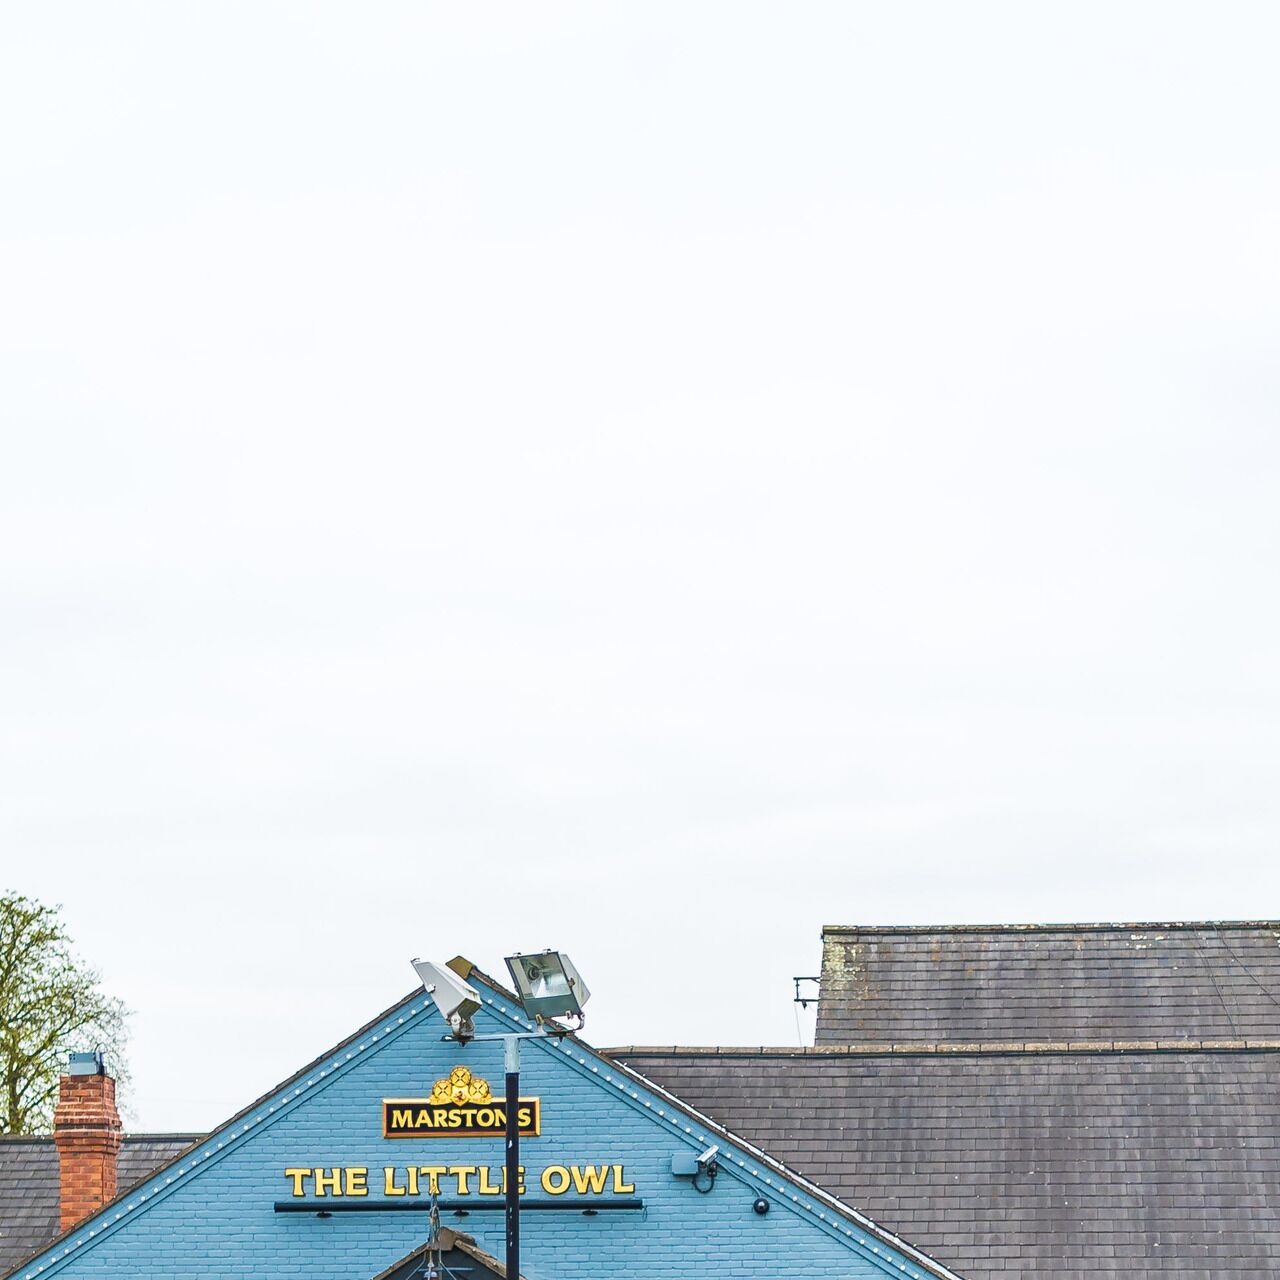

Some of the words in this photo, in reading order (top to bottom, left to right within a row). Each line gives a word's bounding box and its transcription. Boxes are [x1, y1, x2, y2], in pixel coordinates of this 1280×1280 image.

[391, 1108, 532, 1128] MARSTONS
[284, 1166, 369, 1197] THE
[540, 1164, 635, 1195] OWL
